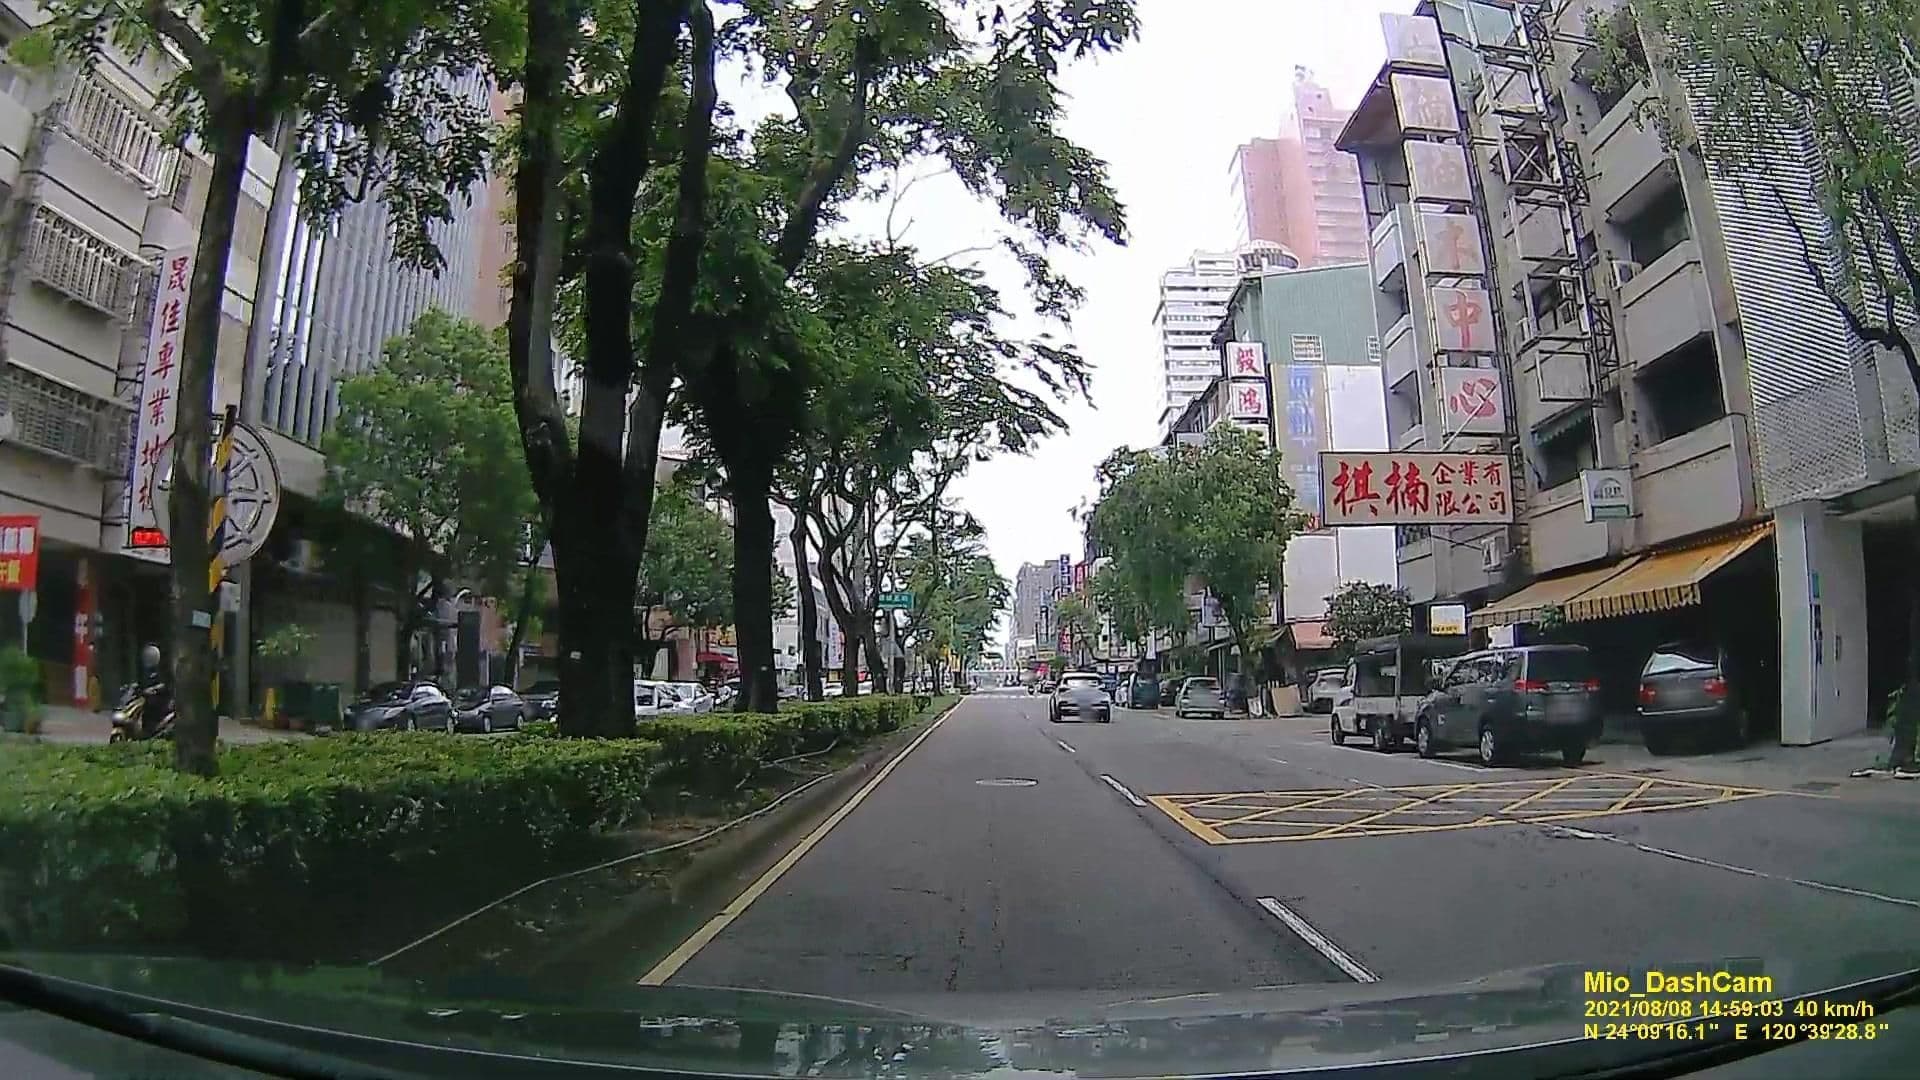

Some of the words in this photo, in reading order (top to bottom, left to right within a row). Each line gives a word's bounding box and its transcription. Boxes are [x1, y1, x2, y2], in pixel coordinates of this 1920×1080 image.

[1331, 460, 1430, 517] 棋楠
[1431, 460, 1503, 487] 企業有
[1435, 491, 1507, 517] 限公司
